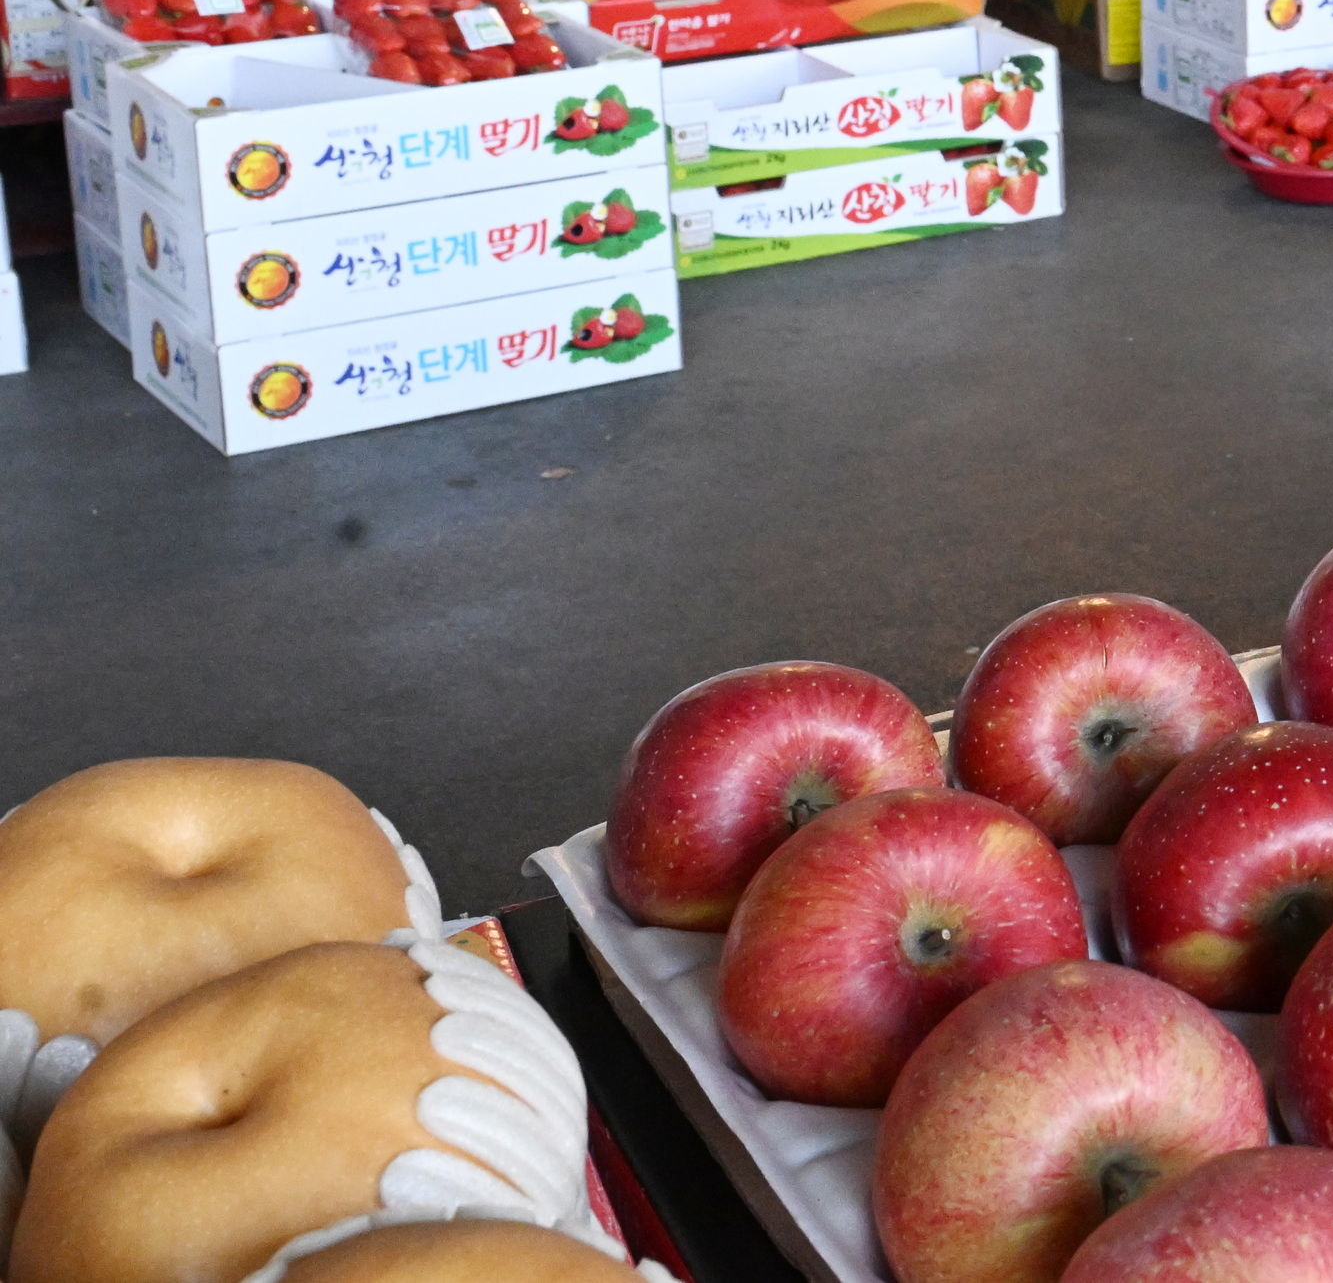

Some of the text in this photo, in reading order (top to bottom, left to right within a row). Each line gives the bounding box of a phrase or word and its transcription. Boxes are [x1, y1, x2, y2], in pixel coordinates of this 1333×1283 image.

[314, 114, 541, 180] 산청 단계 딸기
[772, 113, 831, 138] 지리산
[839, 99, 893, 135] 산청
[905, 92, 954, 123] 딸기
[777, 198, 835, 224] 지리산
[843, 183, 897, 221] 산청
[910, 177, 958, 208] 딸기
[323, 219, 548, 288] 산청 단계 딸기
[335, 324, 557, 396] 산청 단계 딸기
